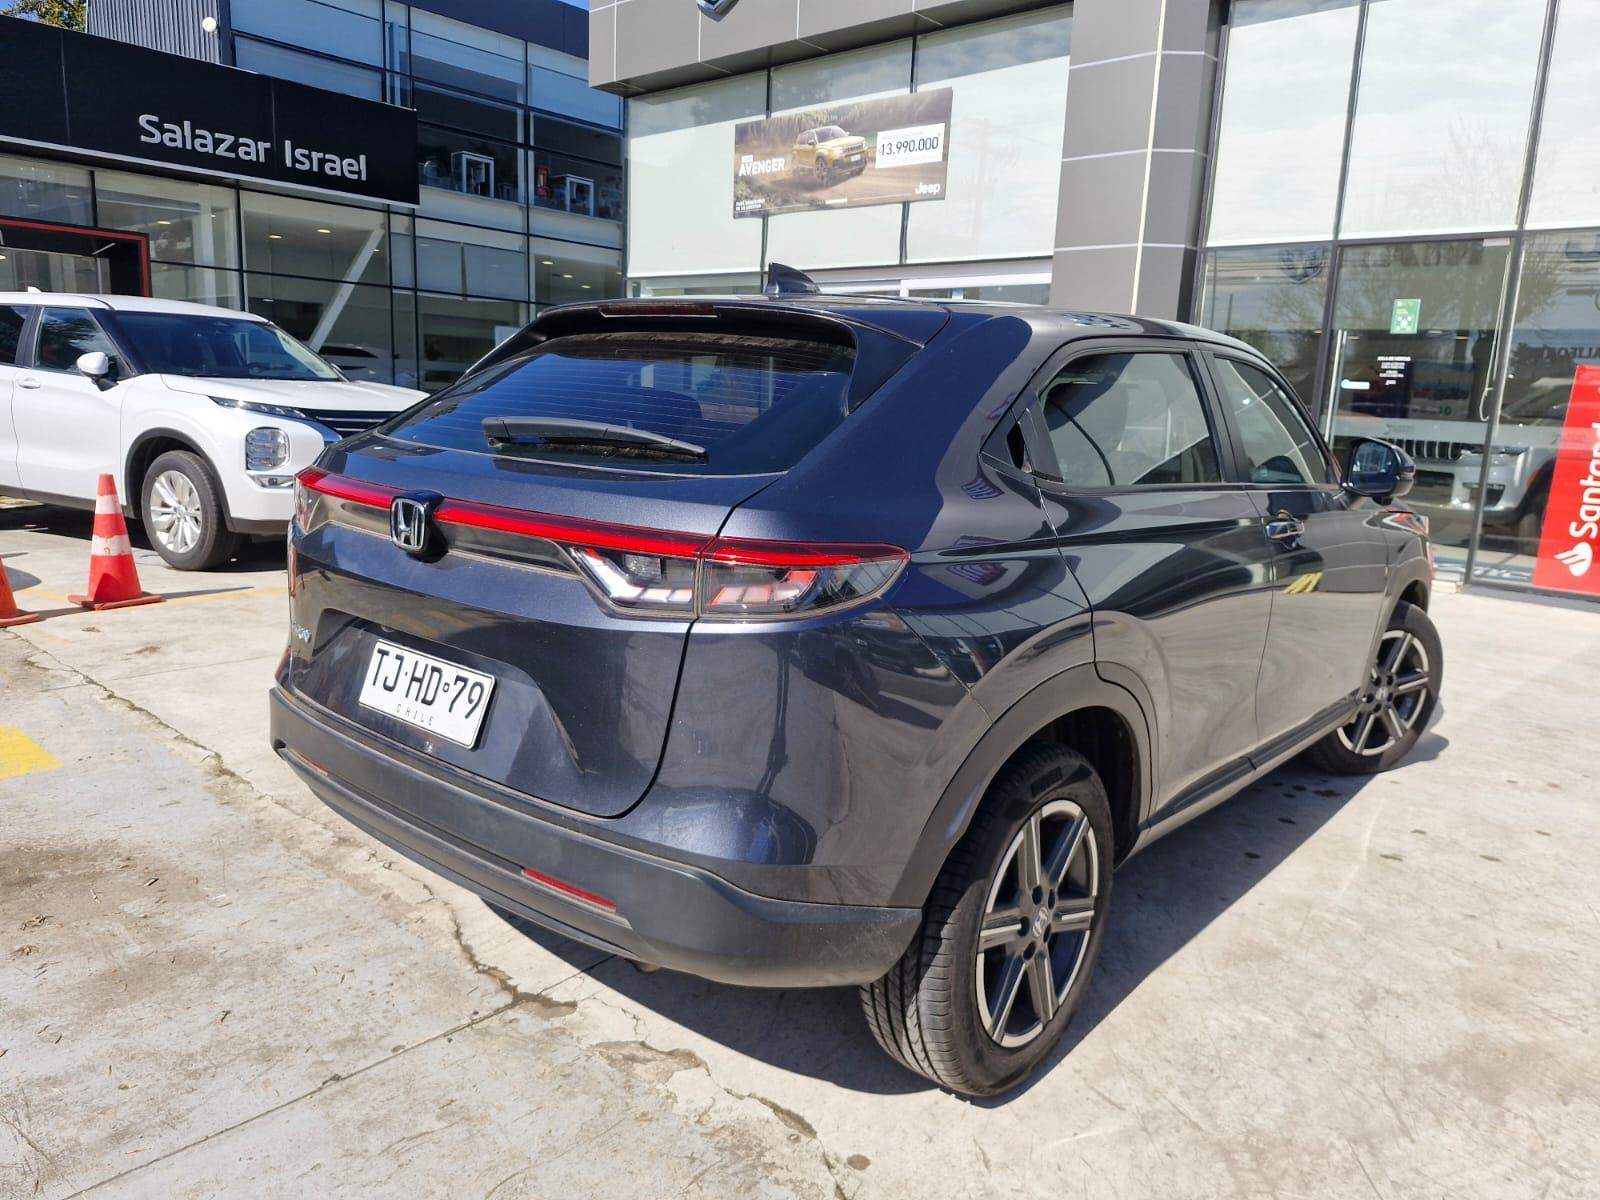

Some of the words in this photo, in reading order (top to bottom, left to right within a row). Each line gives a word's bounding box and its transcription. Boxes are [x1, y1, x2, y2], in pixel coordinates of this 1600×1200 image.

[138, 114, 270, 163] Salazar
[284, 140, 367, 181] Israel
[739, 158, 785, 176] AVENGER
[915, 182, 941, 196] Jeep
